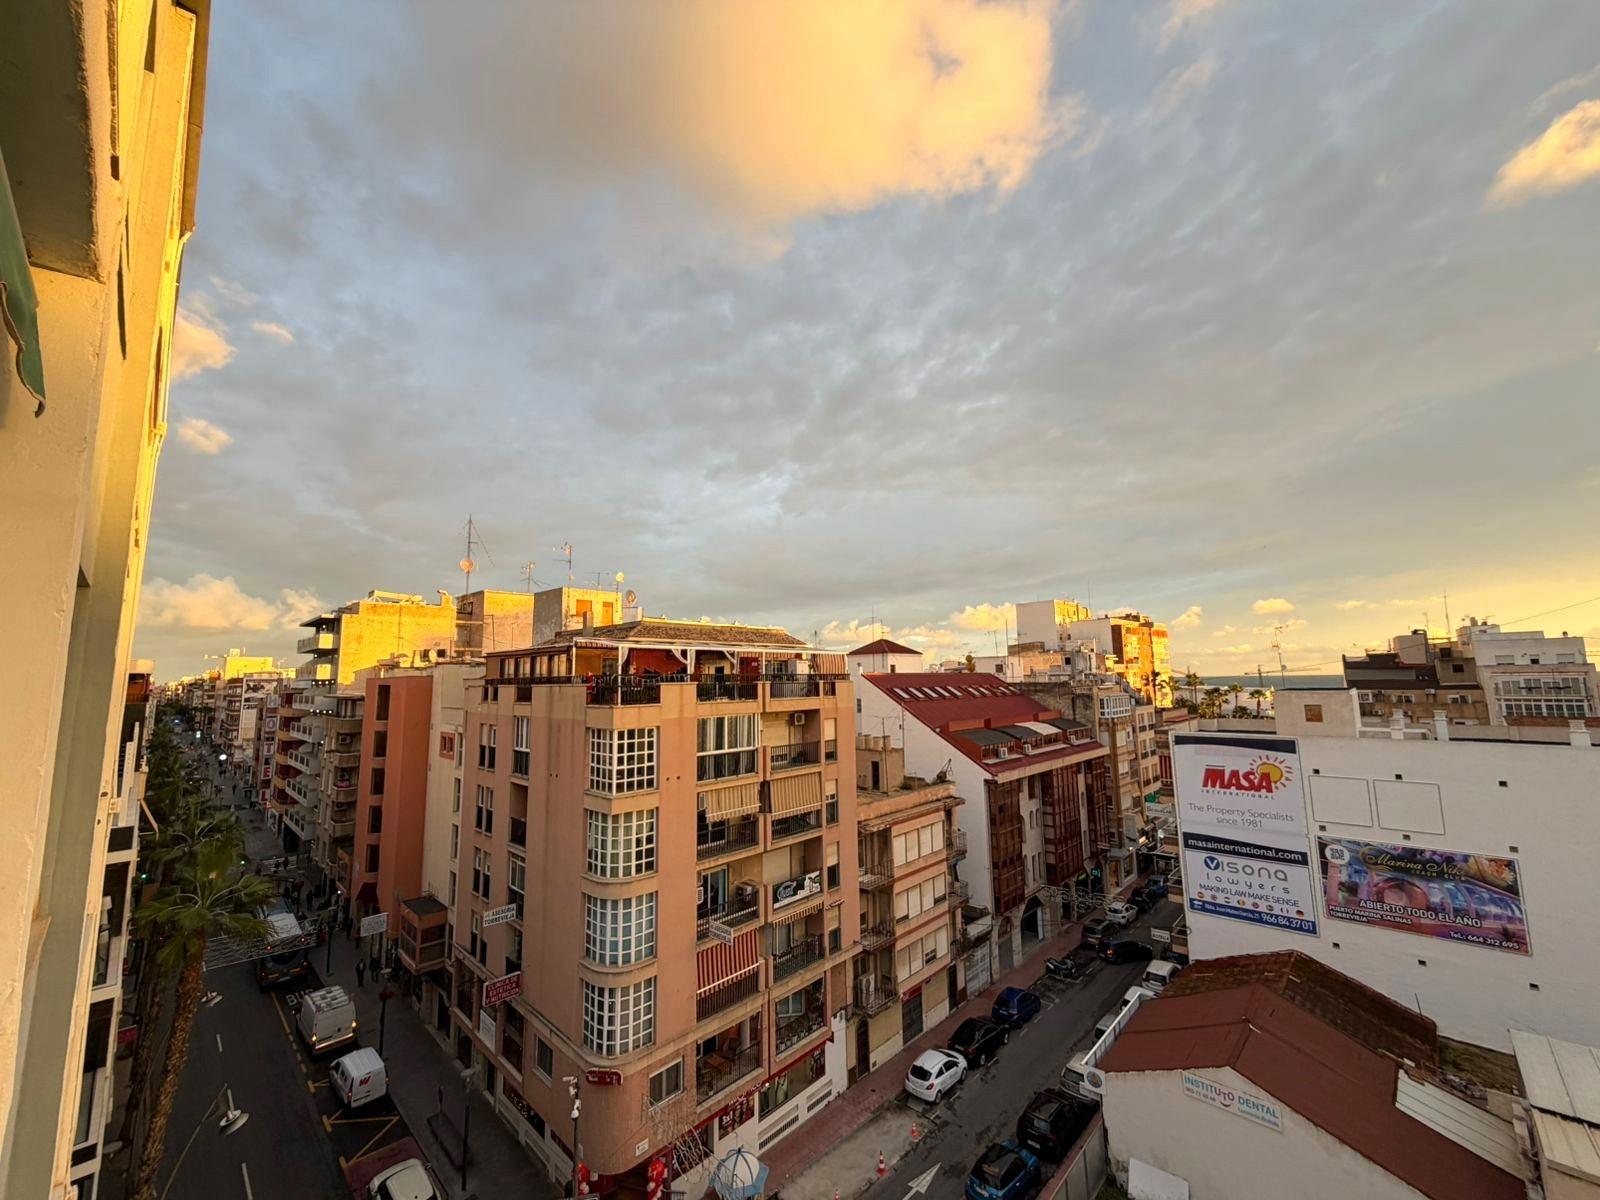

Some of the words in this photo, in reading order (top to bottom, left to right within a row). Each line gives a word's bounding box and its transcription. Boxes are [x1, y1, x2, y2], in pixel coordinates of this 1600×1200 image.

[1202, 768, 1274, 793] MASA
[1188, 803, 1205, 812] The
[1206, 805, 1246, 817] Property
[1248, 809, 1295, 822] Specialists
[1216, 817, 1237, 825] since
[1241, 819, 1263, 828] 1981
[1188, 838, 1302, 861] masainternational.com
[1370, 853, 1422, 869] Marina
[1199, 883, 1229, 894] MAKING
[1230, 888, 1247, 898] LAW
[1248, 892, 1271, 903] MAKE
[1272, 896, 1300, 907] SENSE
[1261, 913, 1278, 924] 966
[1278, 916, 1290, 926] 84
[1290, 919, 1301, 928] 37
[1301, 921, 1313, 930] 01
[1329, 905, 1354, 913] PUERTO
[1354, 909, 1382, 919] MARINA
[1382, 913, 1412, 924] SALINAS
[1329, 911, 1368, 922] TORREVIEJA
[1359, 898, 1404, 915] ABIERTO
[1406, 907, 1433, 920] TODO
[1435, 912, 1453, 923] EL
[1455, 913, 1482, 928] AÑO
[1184, 1076, 1235, 1102] INSTITUTO
[1238, 1095, 1280, 1120] DENTAL
